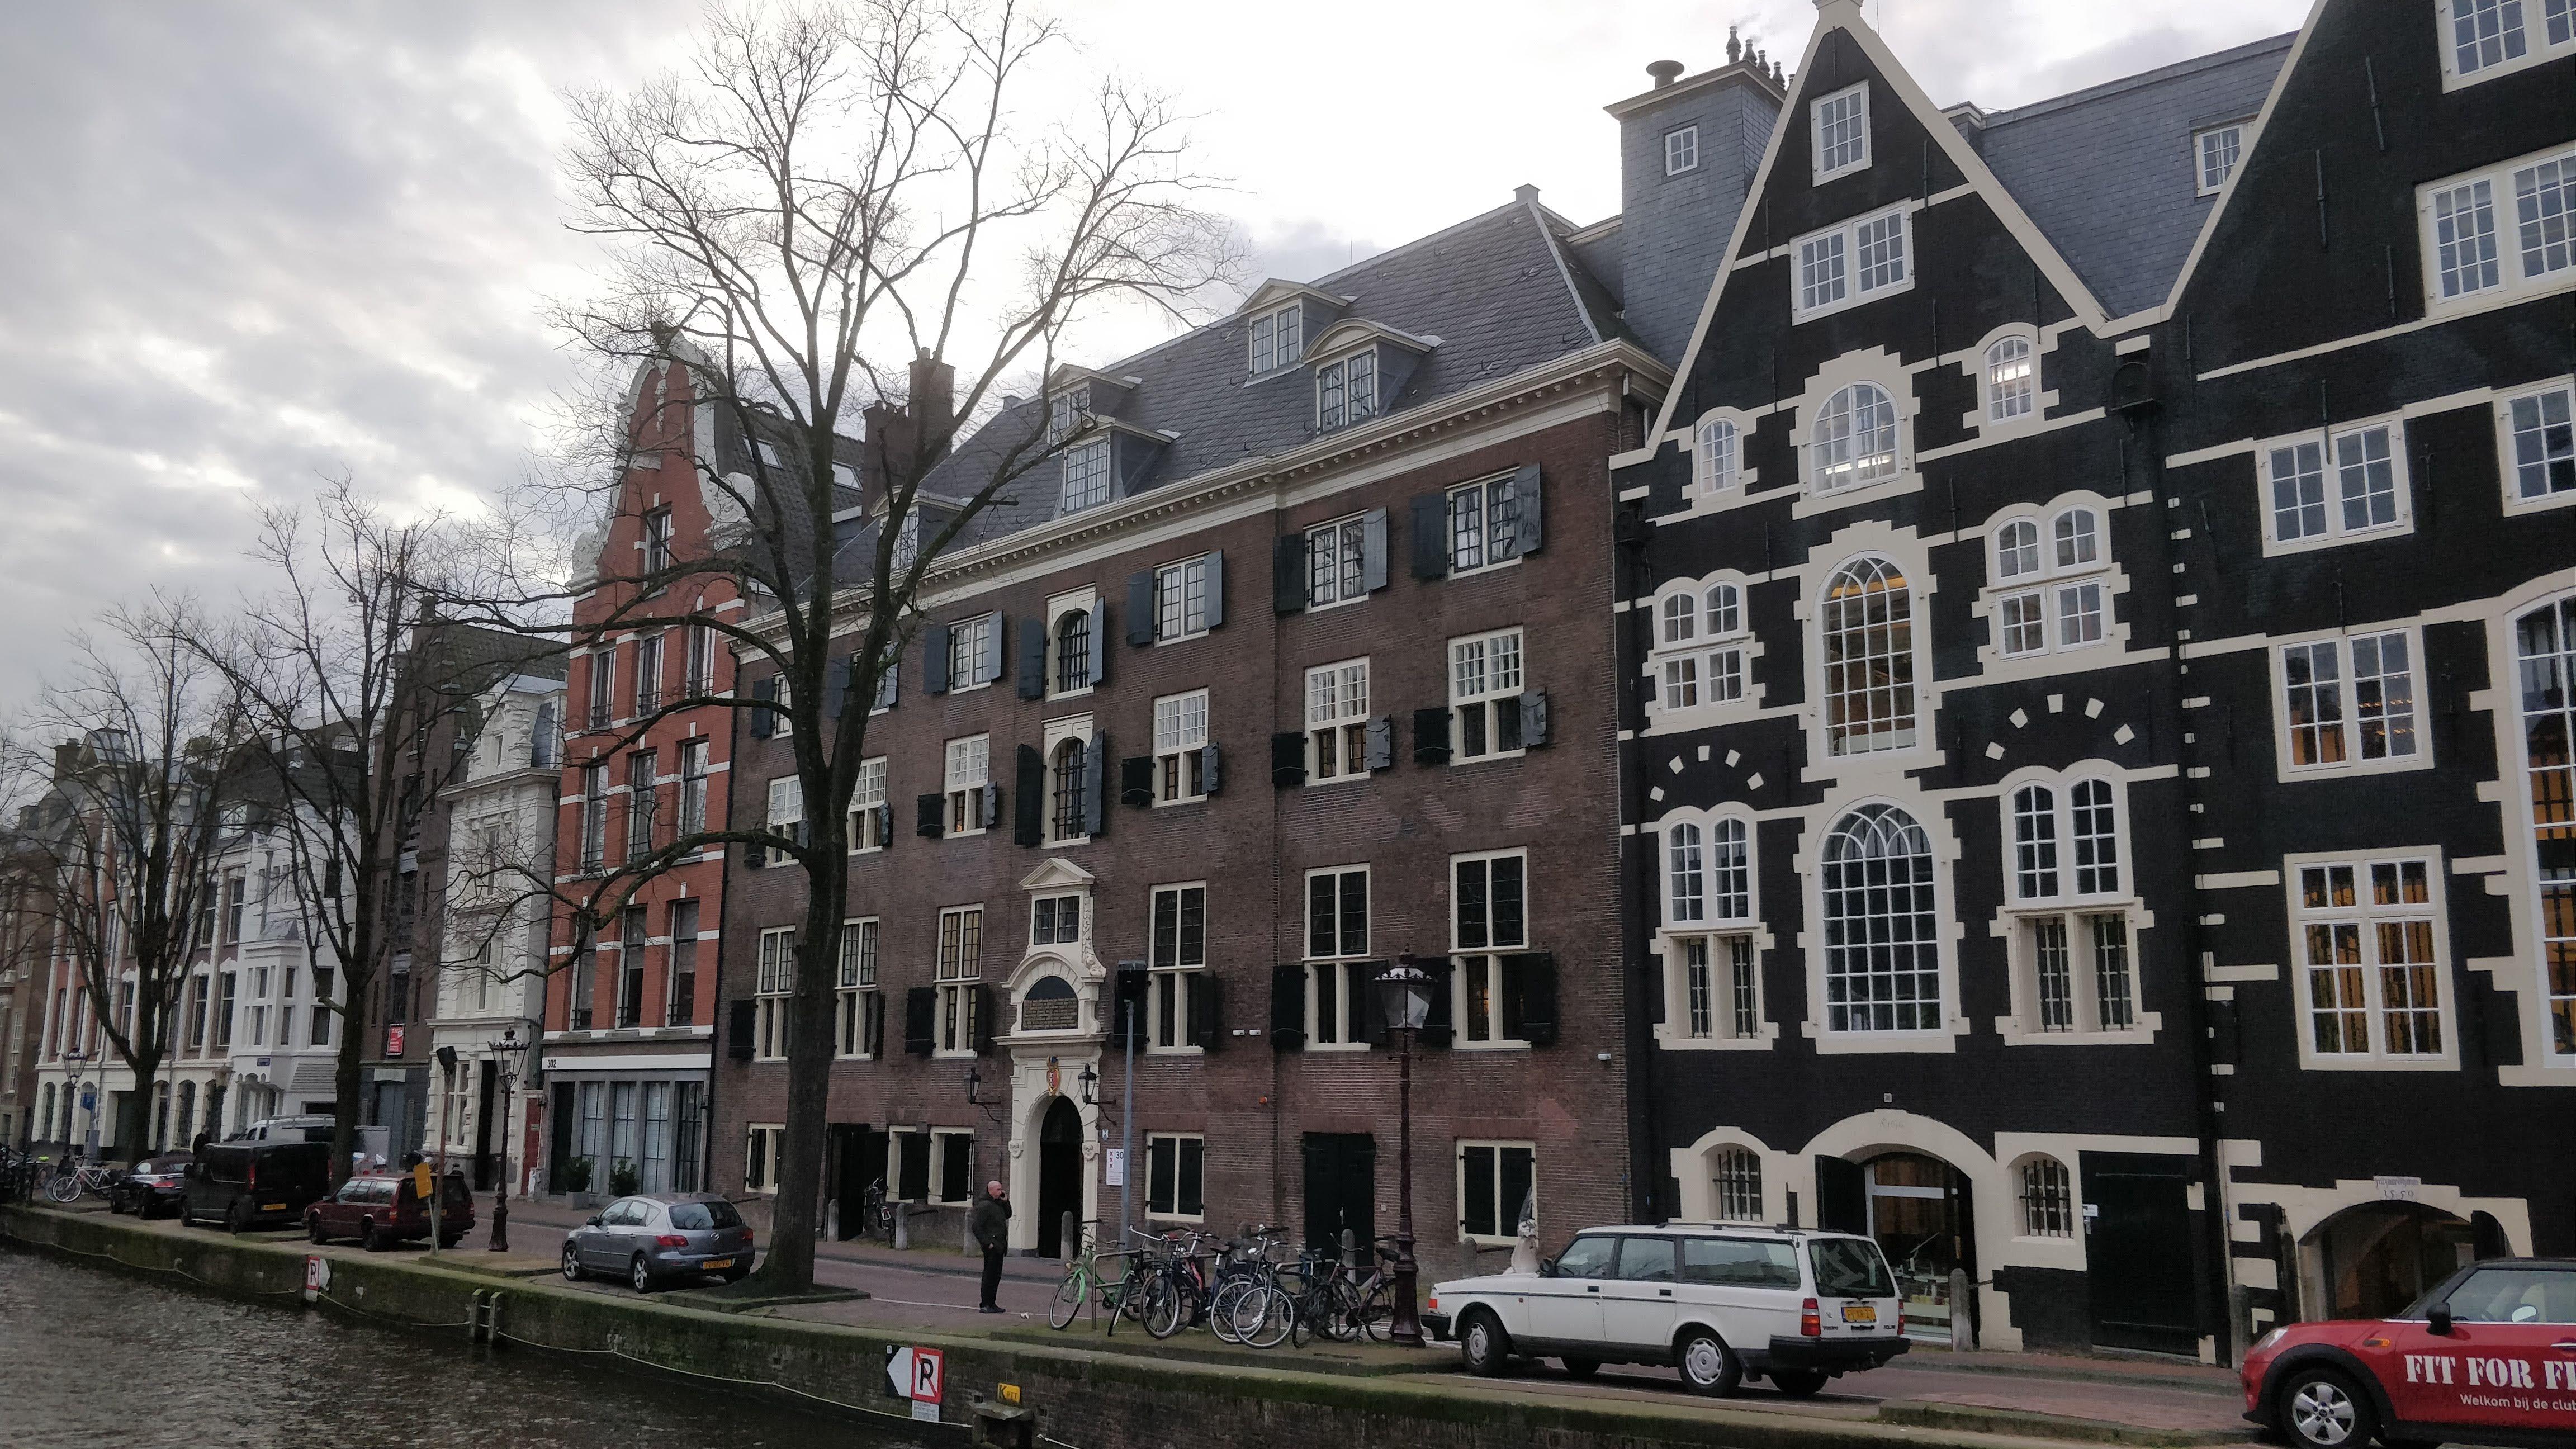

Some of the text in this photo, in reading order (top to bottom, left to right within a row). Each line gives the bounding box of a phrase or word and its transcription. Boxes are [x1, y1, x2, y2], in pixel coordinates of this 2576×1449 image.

[547, 1059, 557, 1068] 302
[2404, 1355, 2455, 1384] FIT
[2466, 1357, 2534, 1389] FOR
[2460, 1394, 2511, 1407] Welkom
[2513, 1396, 2529, 1411] bij
[2533, 1398, 2548, 1409] de
